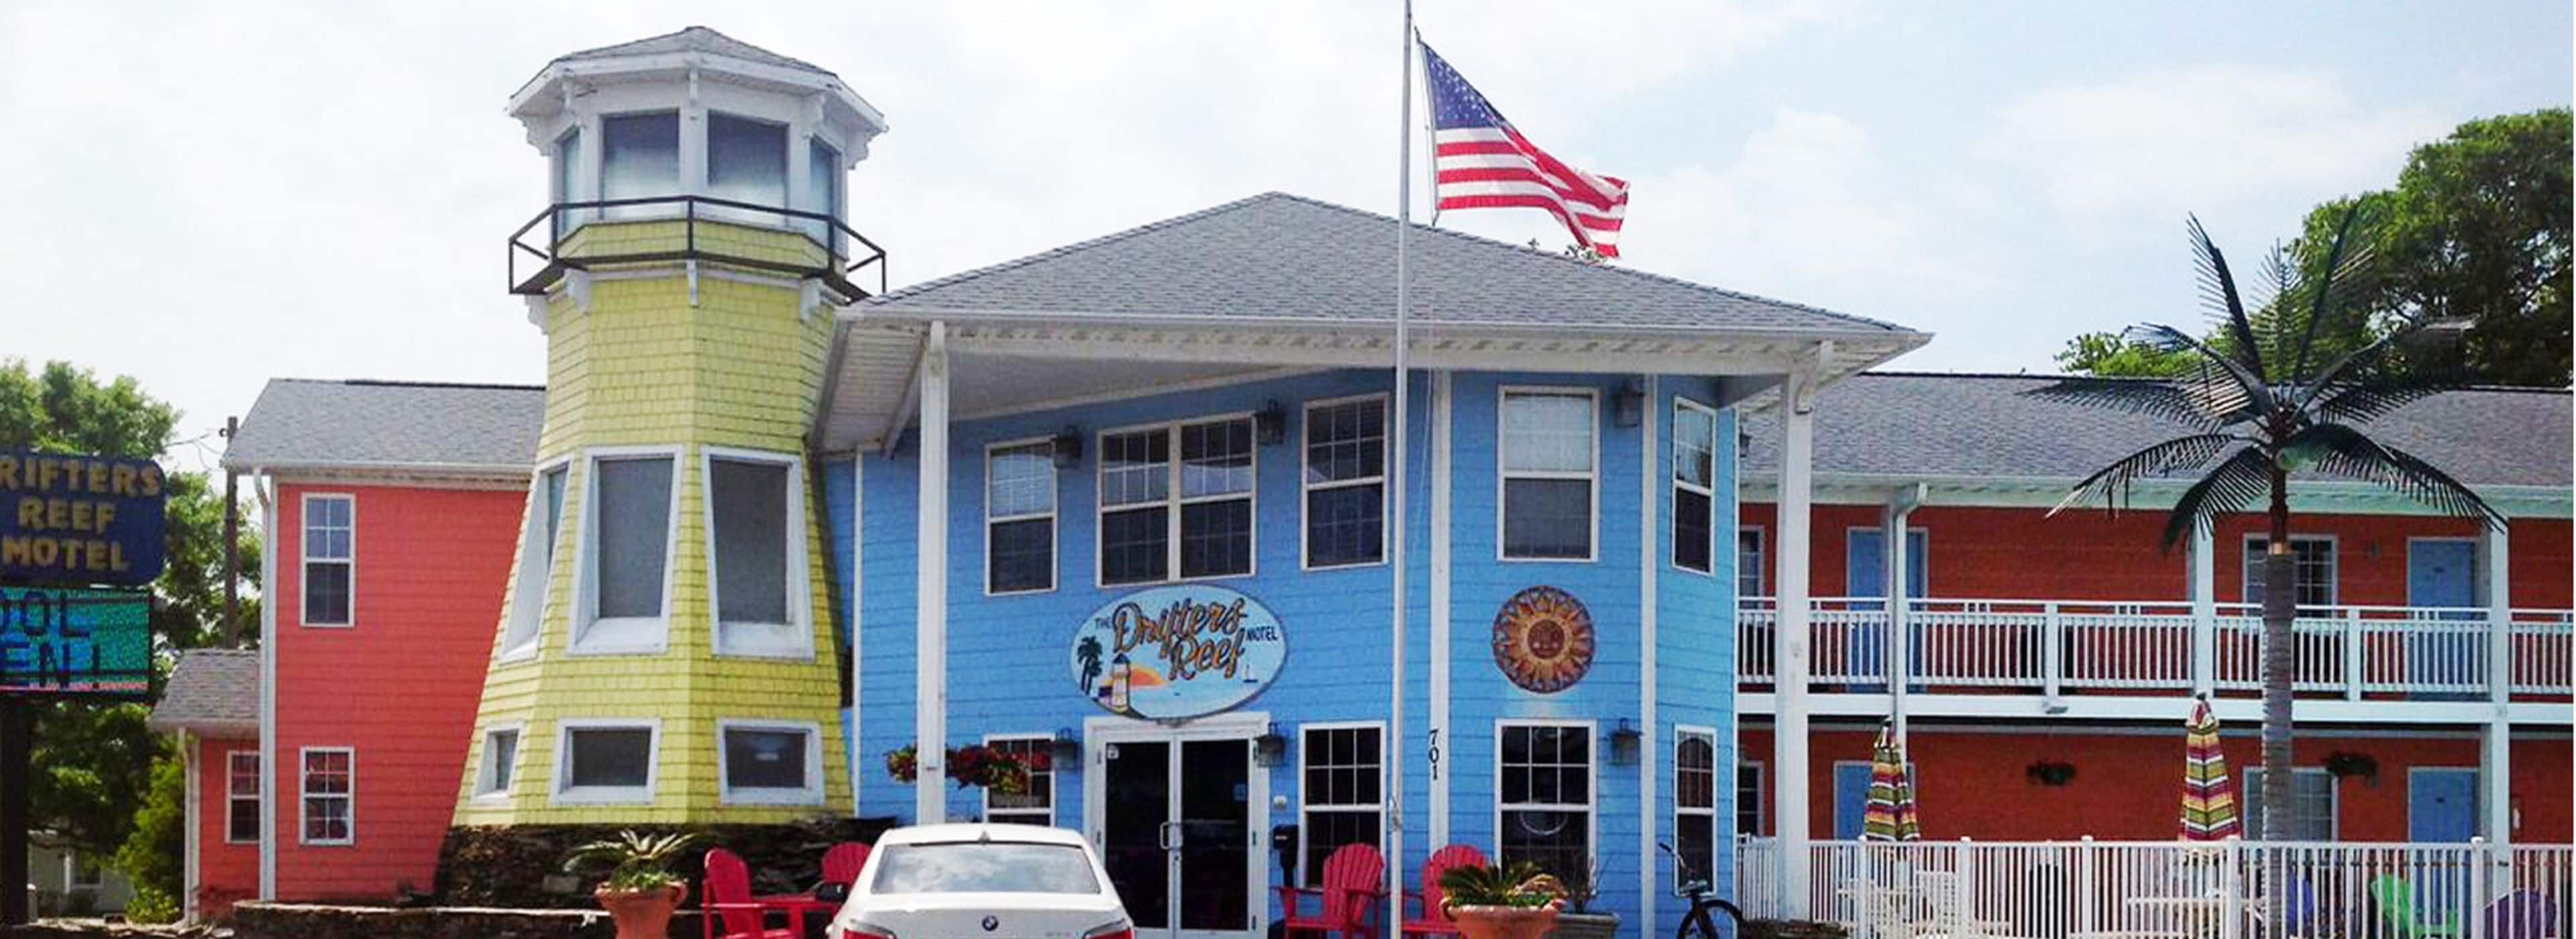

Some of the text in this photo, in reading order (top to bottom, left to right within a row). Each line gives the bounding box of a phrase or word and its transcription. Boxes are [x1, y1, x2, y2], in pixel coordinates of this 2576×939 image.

[18, 498, 116, 533] REEF
[2, 537, 131, 571] MOTEL
[1095, 616, 1112, 630] THE
[1112, 598, 1248, 659] Drifters
[1246, 625, 1278, 641] MOTEL
[1169, 627, 1246, 681] Reef
[1428, 728, 1439, 780] 701
